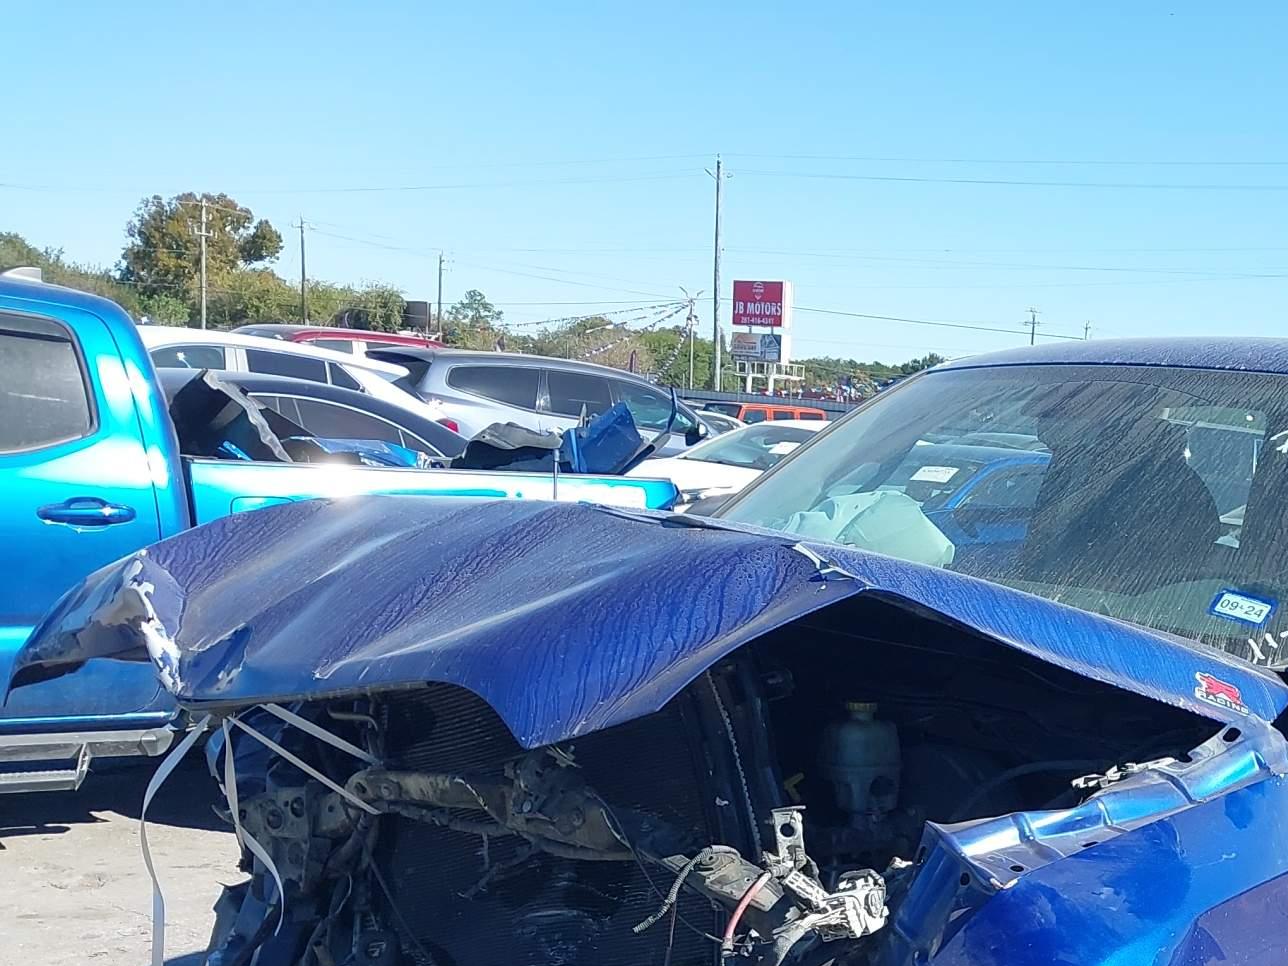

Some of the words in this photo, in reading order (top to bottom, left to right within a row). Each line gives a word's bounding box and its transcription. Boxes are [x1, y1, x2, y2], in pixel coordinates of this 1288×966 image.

[734, 301, 745, 314] JB
[746, 301, 782, 316] MOTORS
[1199, 688, 1249, 715] RACING
